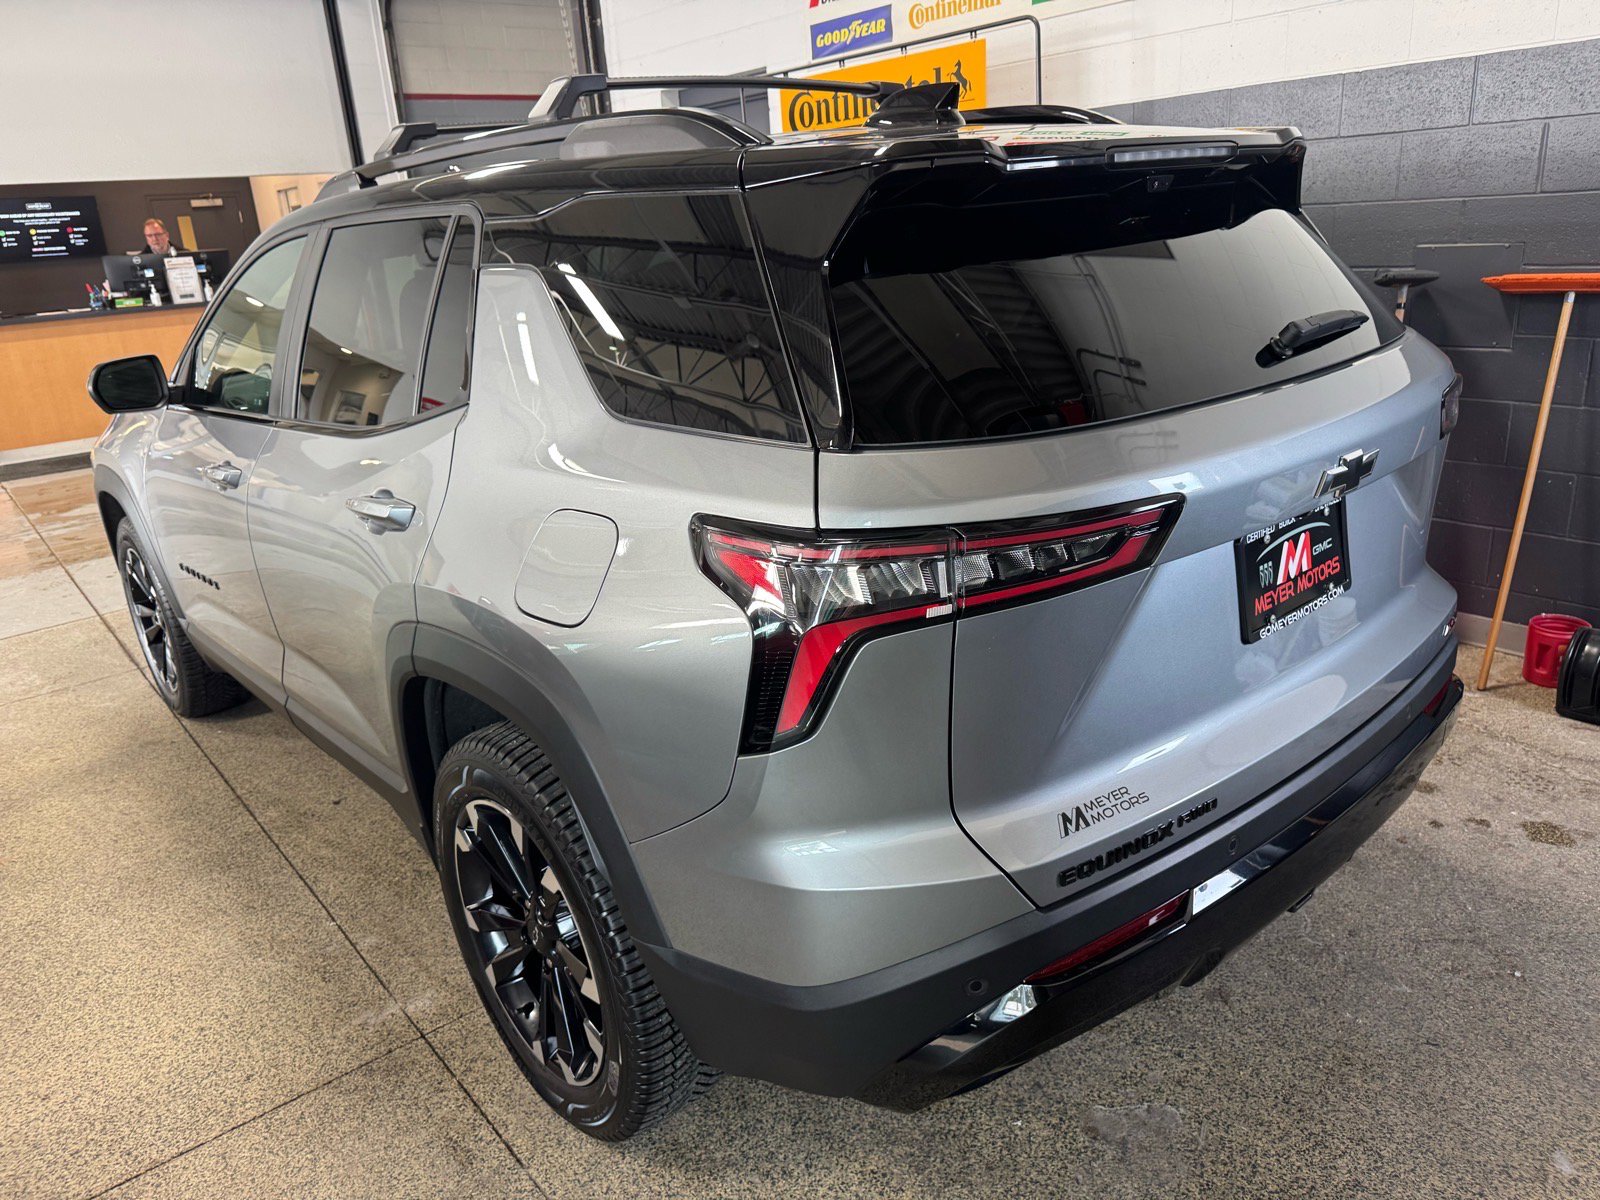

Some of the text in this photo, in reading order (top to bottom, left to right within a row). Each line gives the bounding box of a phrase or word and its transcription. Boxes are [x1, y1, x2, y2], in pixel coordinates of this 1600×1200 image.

[908, 0, 1002, 30] Continena
[815, 18, 886, 48] GOODYEAR
[1312, 537, 1333, 555] GMC
[1254, 556, 1341, 617] MEYER MOTORS
[1259, 585, 1345, 639] GOMEYERMOTORS.COM
[1083, 786, 1131, 813] MEYER
[1090, 791, 1150, 825] MOTORS
[1057, 818, 1176, 888] EQUINOX
